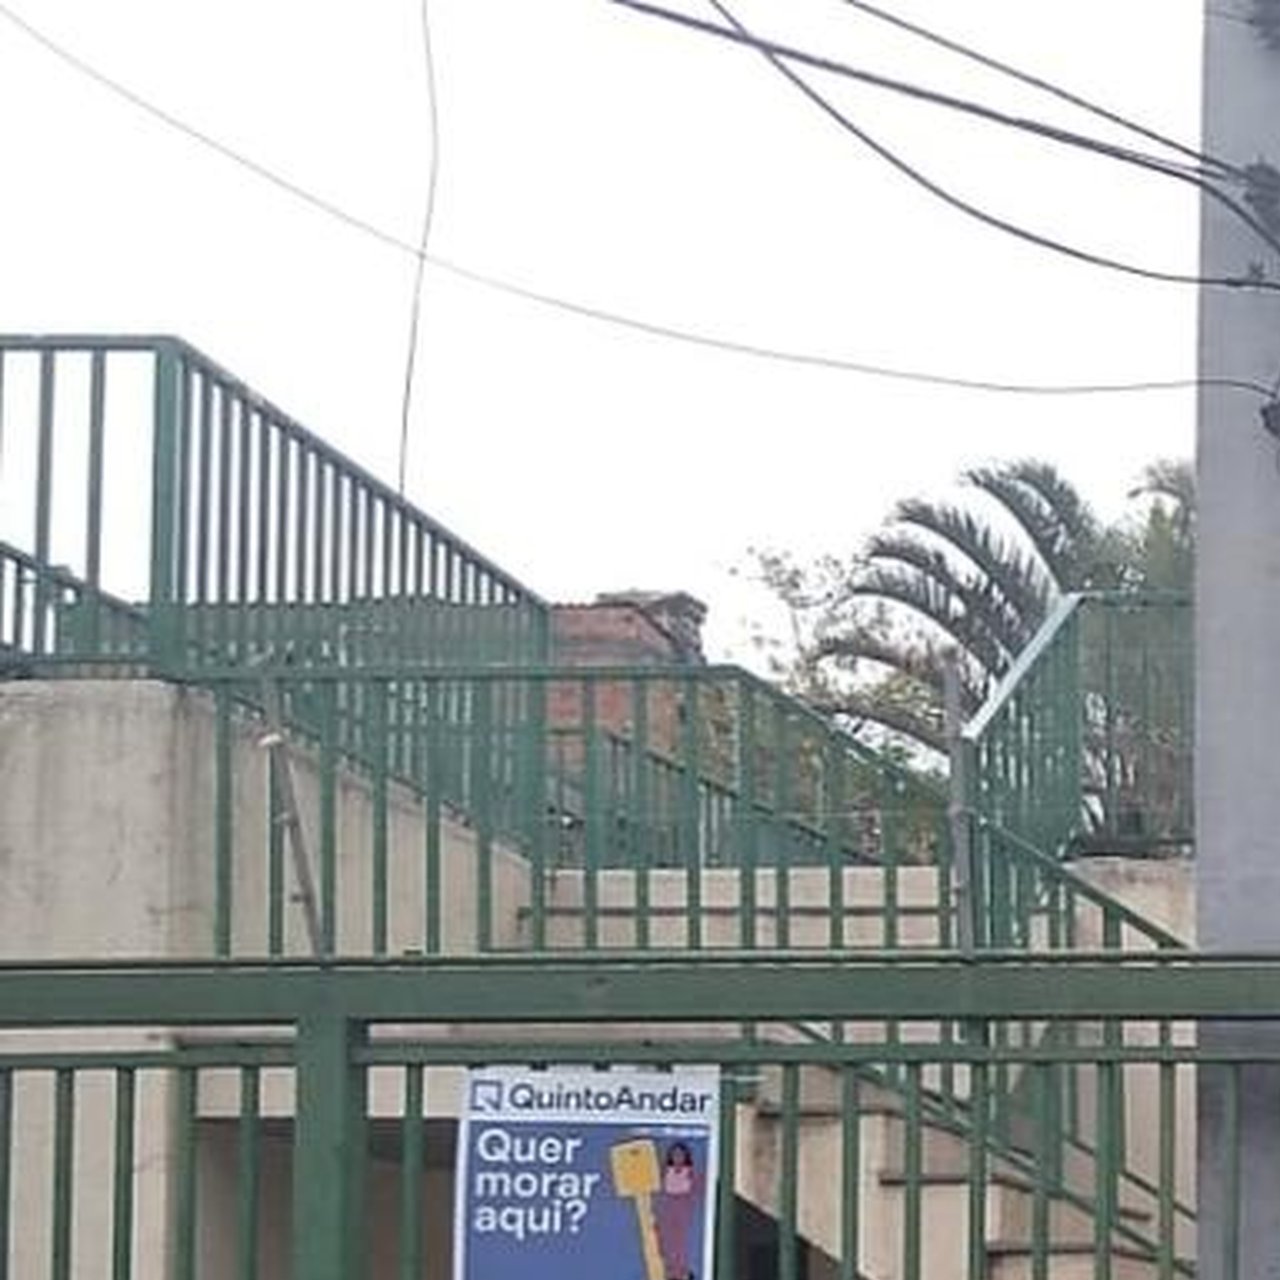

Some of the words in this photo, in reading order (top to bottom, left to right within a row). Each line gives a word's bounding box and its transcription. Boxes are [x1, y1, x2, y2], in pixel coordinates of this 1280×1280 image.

[508, 1083, 711, 1112] QuintoAndar
[476, 1129, 582, 1163] Quer
[475, 1170, 600, 1197] morar
[475, 1199, 588, 1240] aqui?
